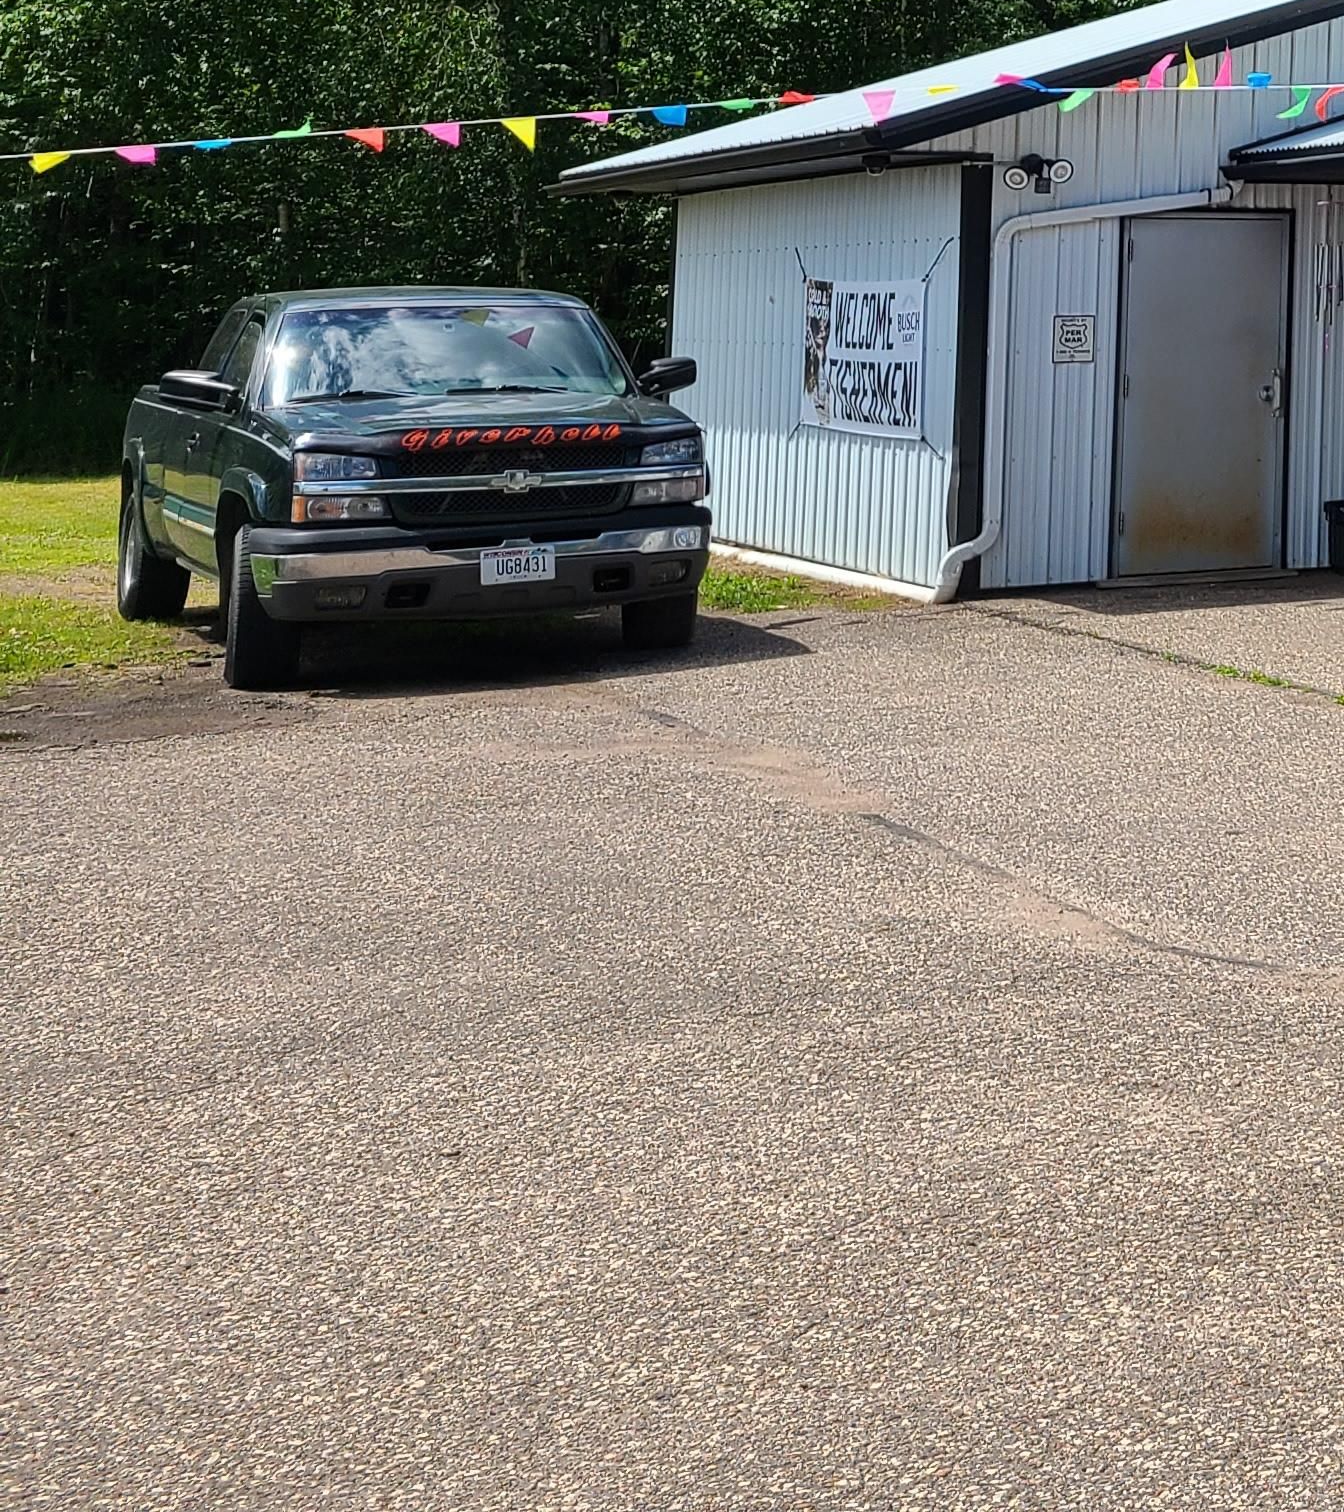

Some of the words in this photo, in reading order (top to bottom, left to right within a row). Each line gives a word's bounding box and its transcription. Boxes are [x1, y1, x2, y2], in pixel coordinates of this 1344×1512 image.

[835, 291, 896, 351] WELCOME
[898, 311, 921, 332] BUSCH
[1065, 329, 1082, 337] PER
[829, 358, 918, 428] FISHERMEN!
[496, 554, 547, 576] UG8431
